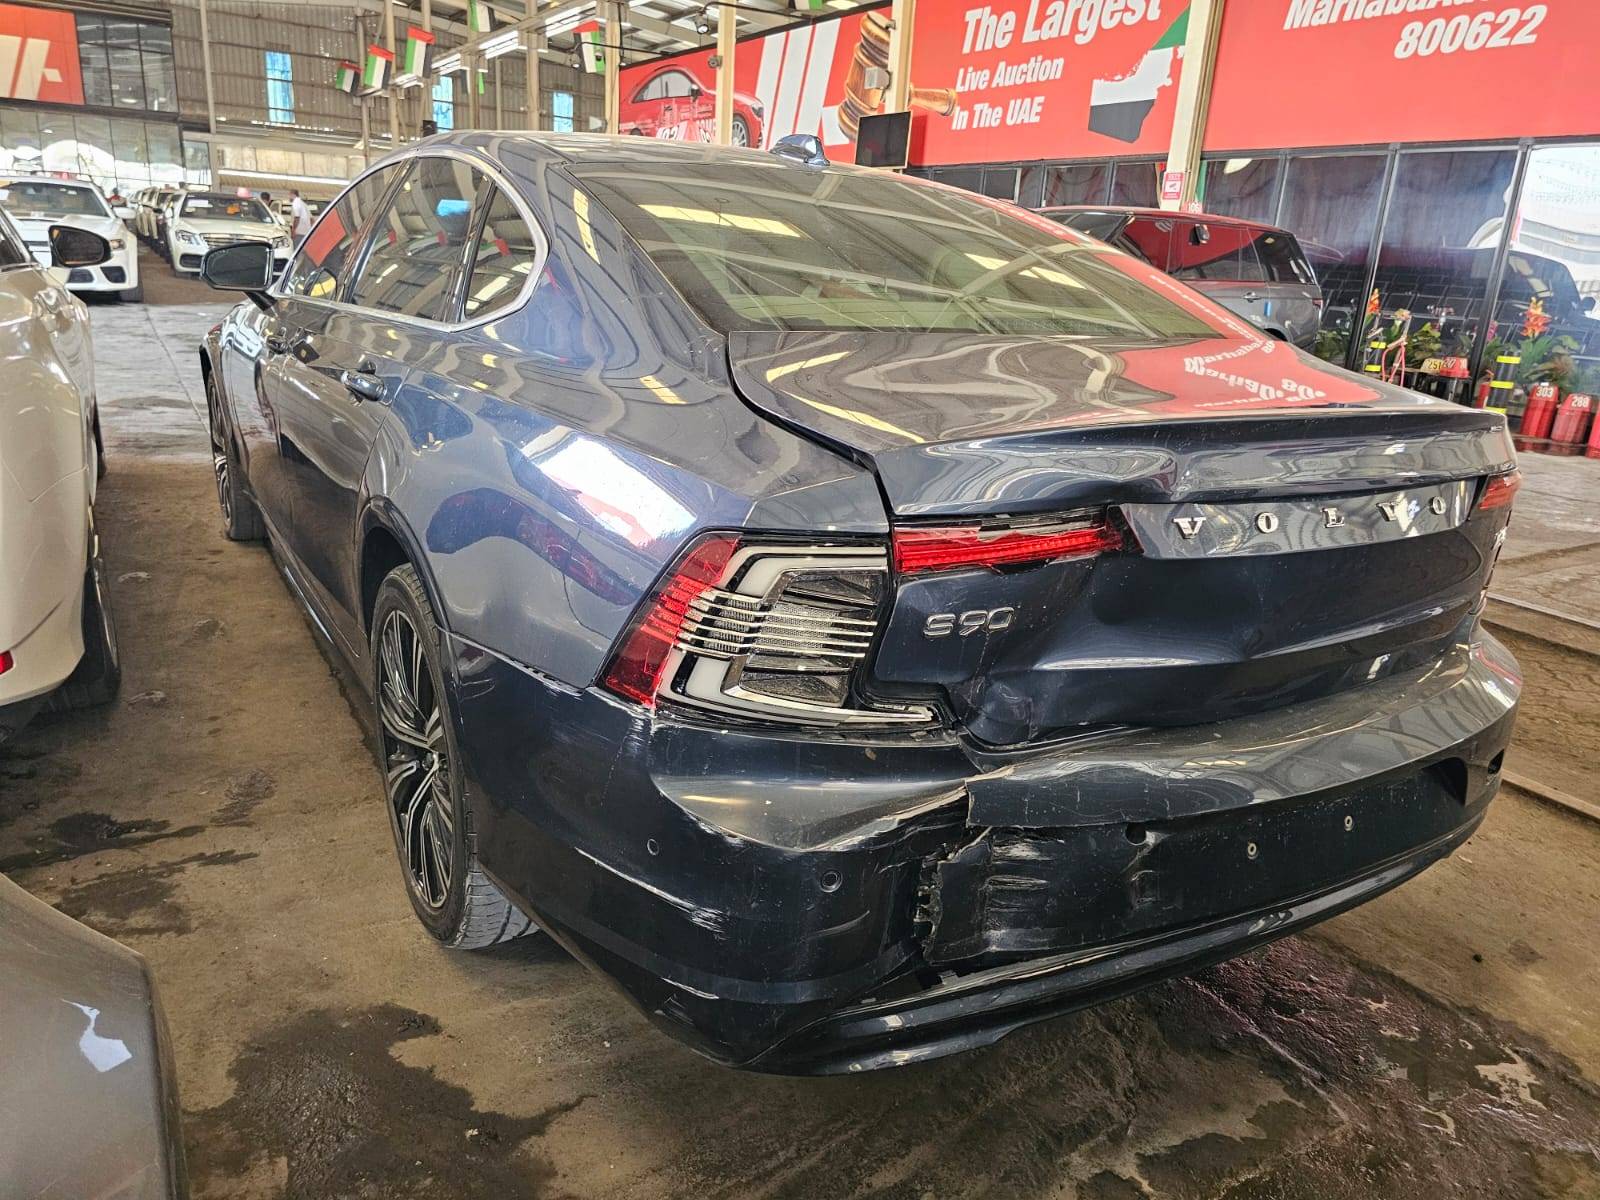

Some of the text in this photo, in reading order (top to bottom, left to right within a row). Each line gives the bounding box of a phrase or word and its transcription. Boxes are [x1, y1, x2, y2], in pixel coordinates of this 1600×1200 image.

[962, 0, 1161, 54] The Largest
[1393, 4, 1548, 59] 800622
[956, 55, 1065, 93] Live Auction
[951, 96, 1045, 131] In The UAE
[1173, 495, 1447, 540] VOLVO
[922, 606, 1015, 637] S90
